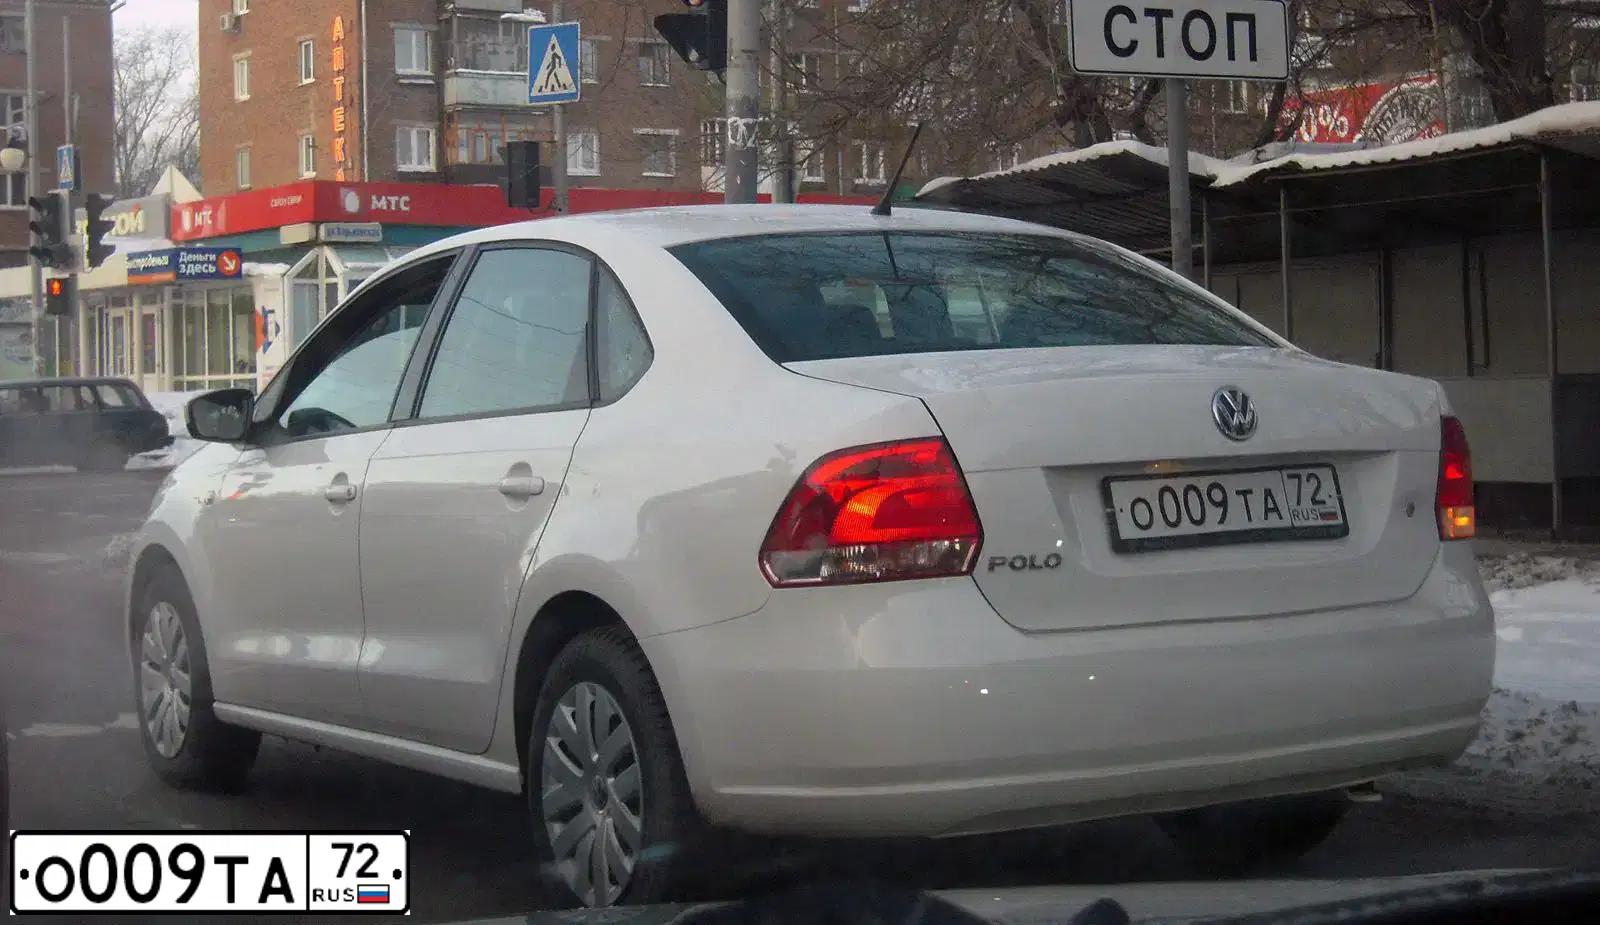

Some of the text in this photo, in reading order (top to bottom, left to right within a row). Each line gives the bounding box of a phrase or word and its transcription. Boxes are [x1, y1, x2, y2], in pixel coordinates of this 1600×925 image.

[1103, 4, 1258, 63] СТОП
[371, 194, 411, 211] МТС
[179, 251, 217, 264] Деньги
[1286, 472, 1326, 506] 72
[1292, 507, 1319, 521] RUS
[987, 553, 1062, 572] POLO
